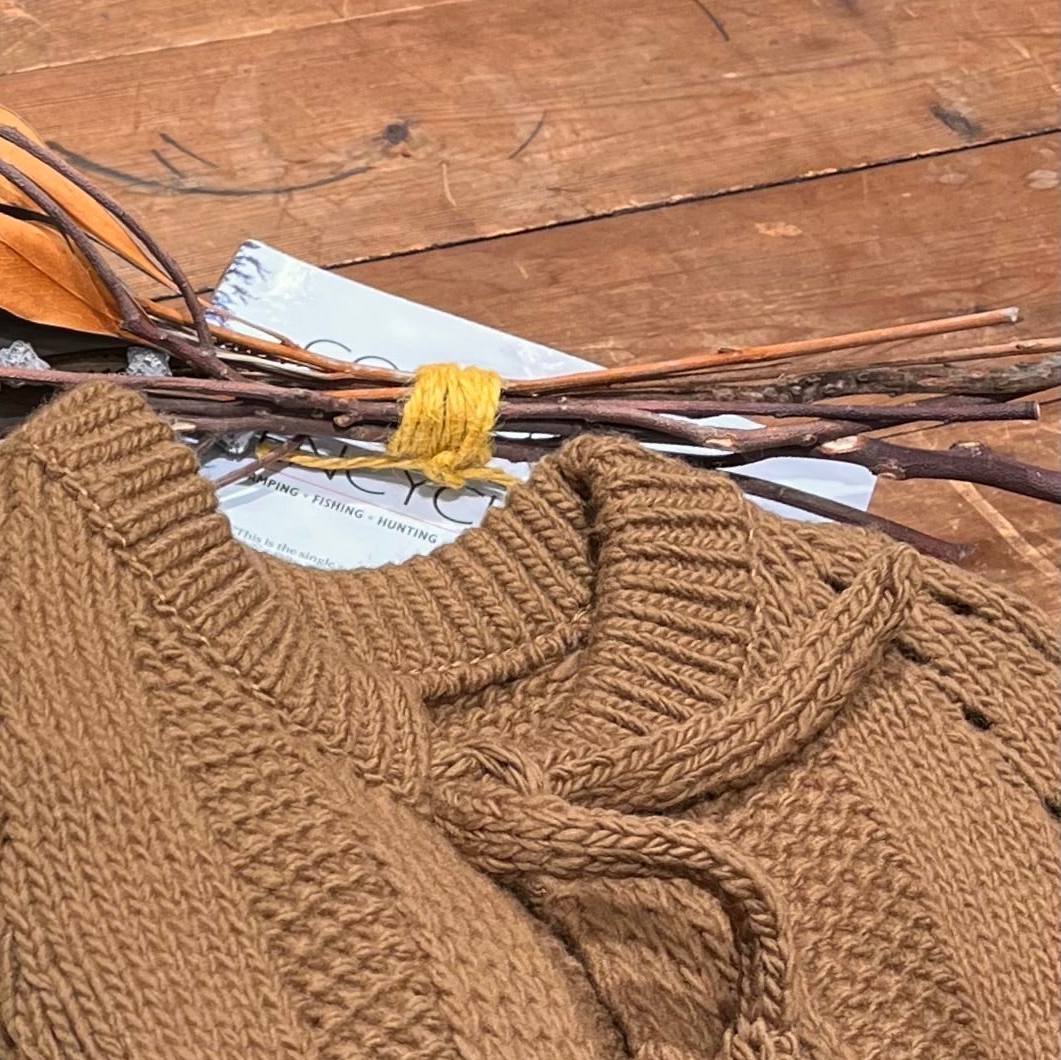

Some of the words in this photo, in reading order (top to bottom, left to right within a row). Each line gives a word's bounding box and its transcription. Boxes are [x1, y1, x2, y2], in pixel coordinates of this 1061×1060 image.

[311, 494, 365, 520] FISHING
[377, 515, 439, 545] HUNTING
[263, 537, 275, 548] is
[276, 543, 298, 556] the
[298, 550, 336, 569] single
